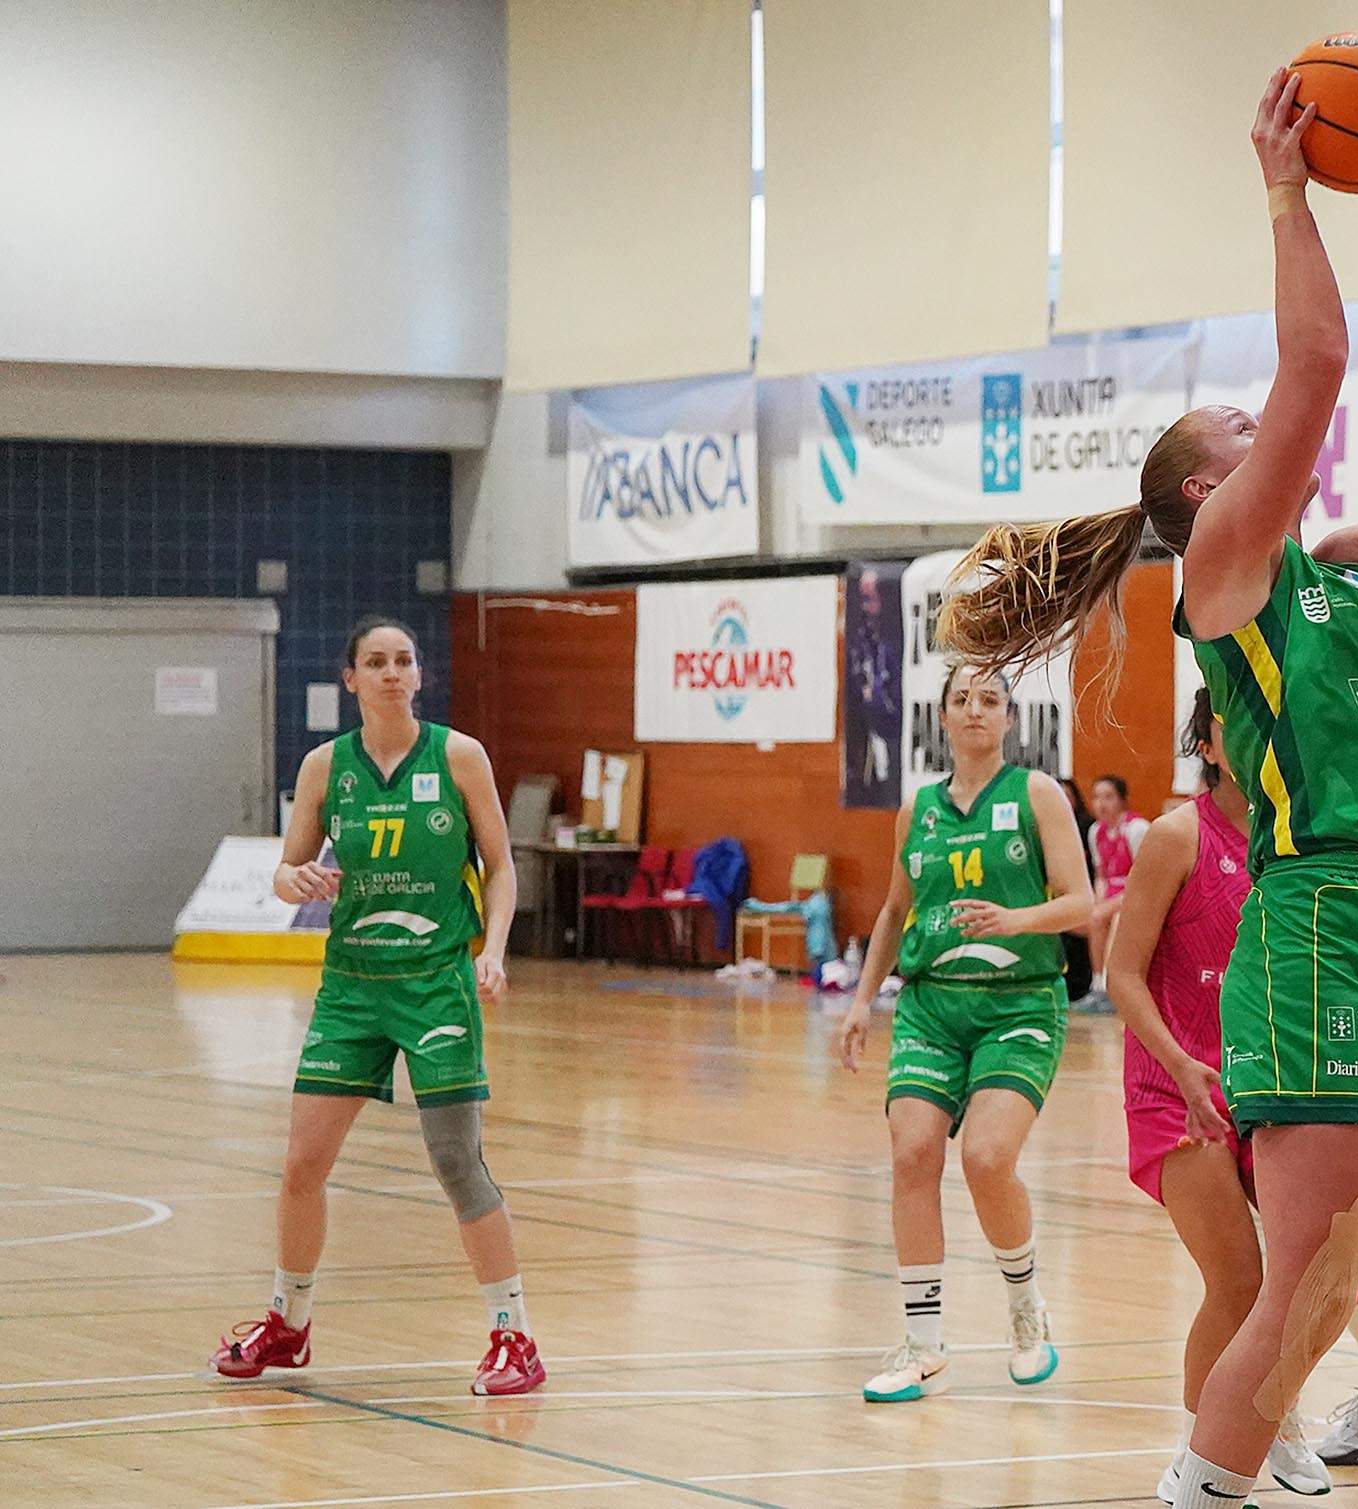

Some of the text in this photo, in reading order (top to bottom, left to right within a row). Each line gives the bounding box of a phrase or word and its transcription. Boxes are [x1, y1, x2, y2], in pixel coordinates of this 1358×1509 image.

[866, 377, 951, 410] DEPORTE
[1030, 376, 1116, 418] XUNTA
[864, 416, 944, 448] GALEGO
[1029, 431, 1060, 471] DE
[590, 432, 748, 520] ABANCA
[673, 649, 796, 690] PESCAMAR
[368, 818, 405, 859] 77
[948, 847, 984, 890] 14
